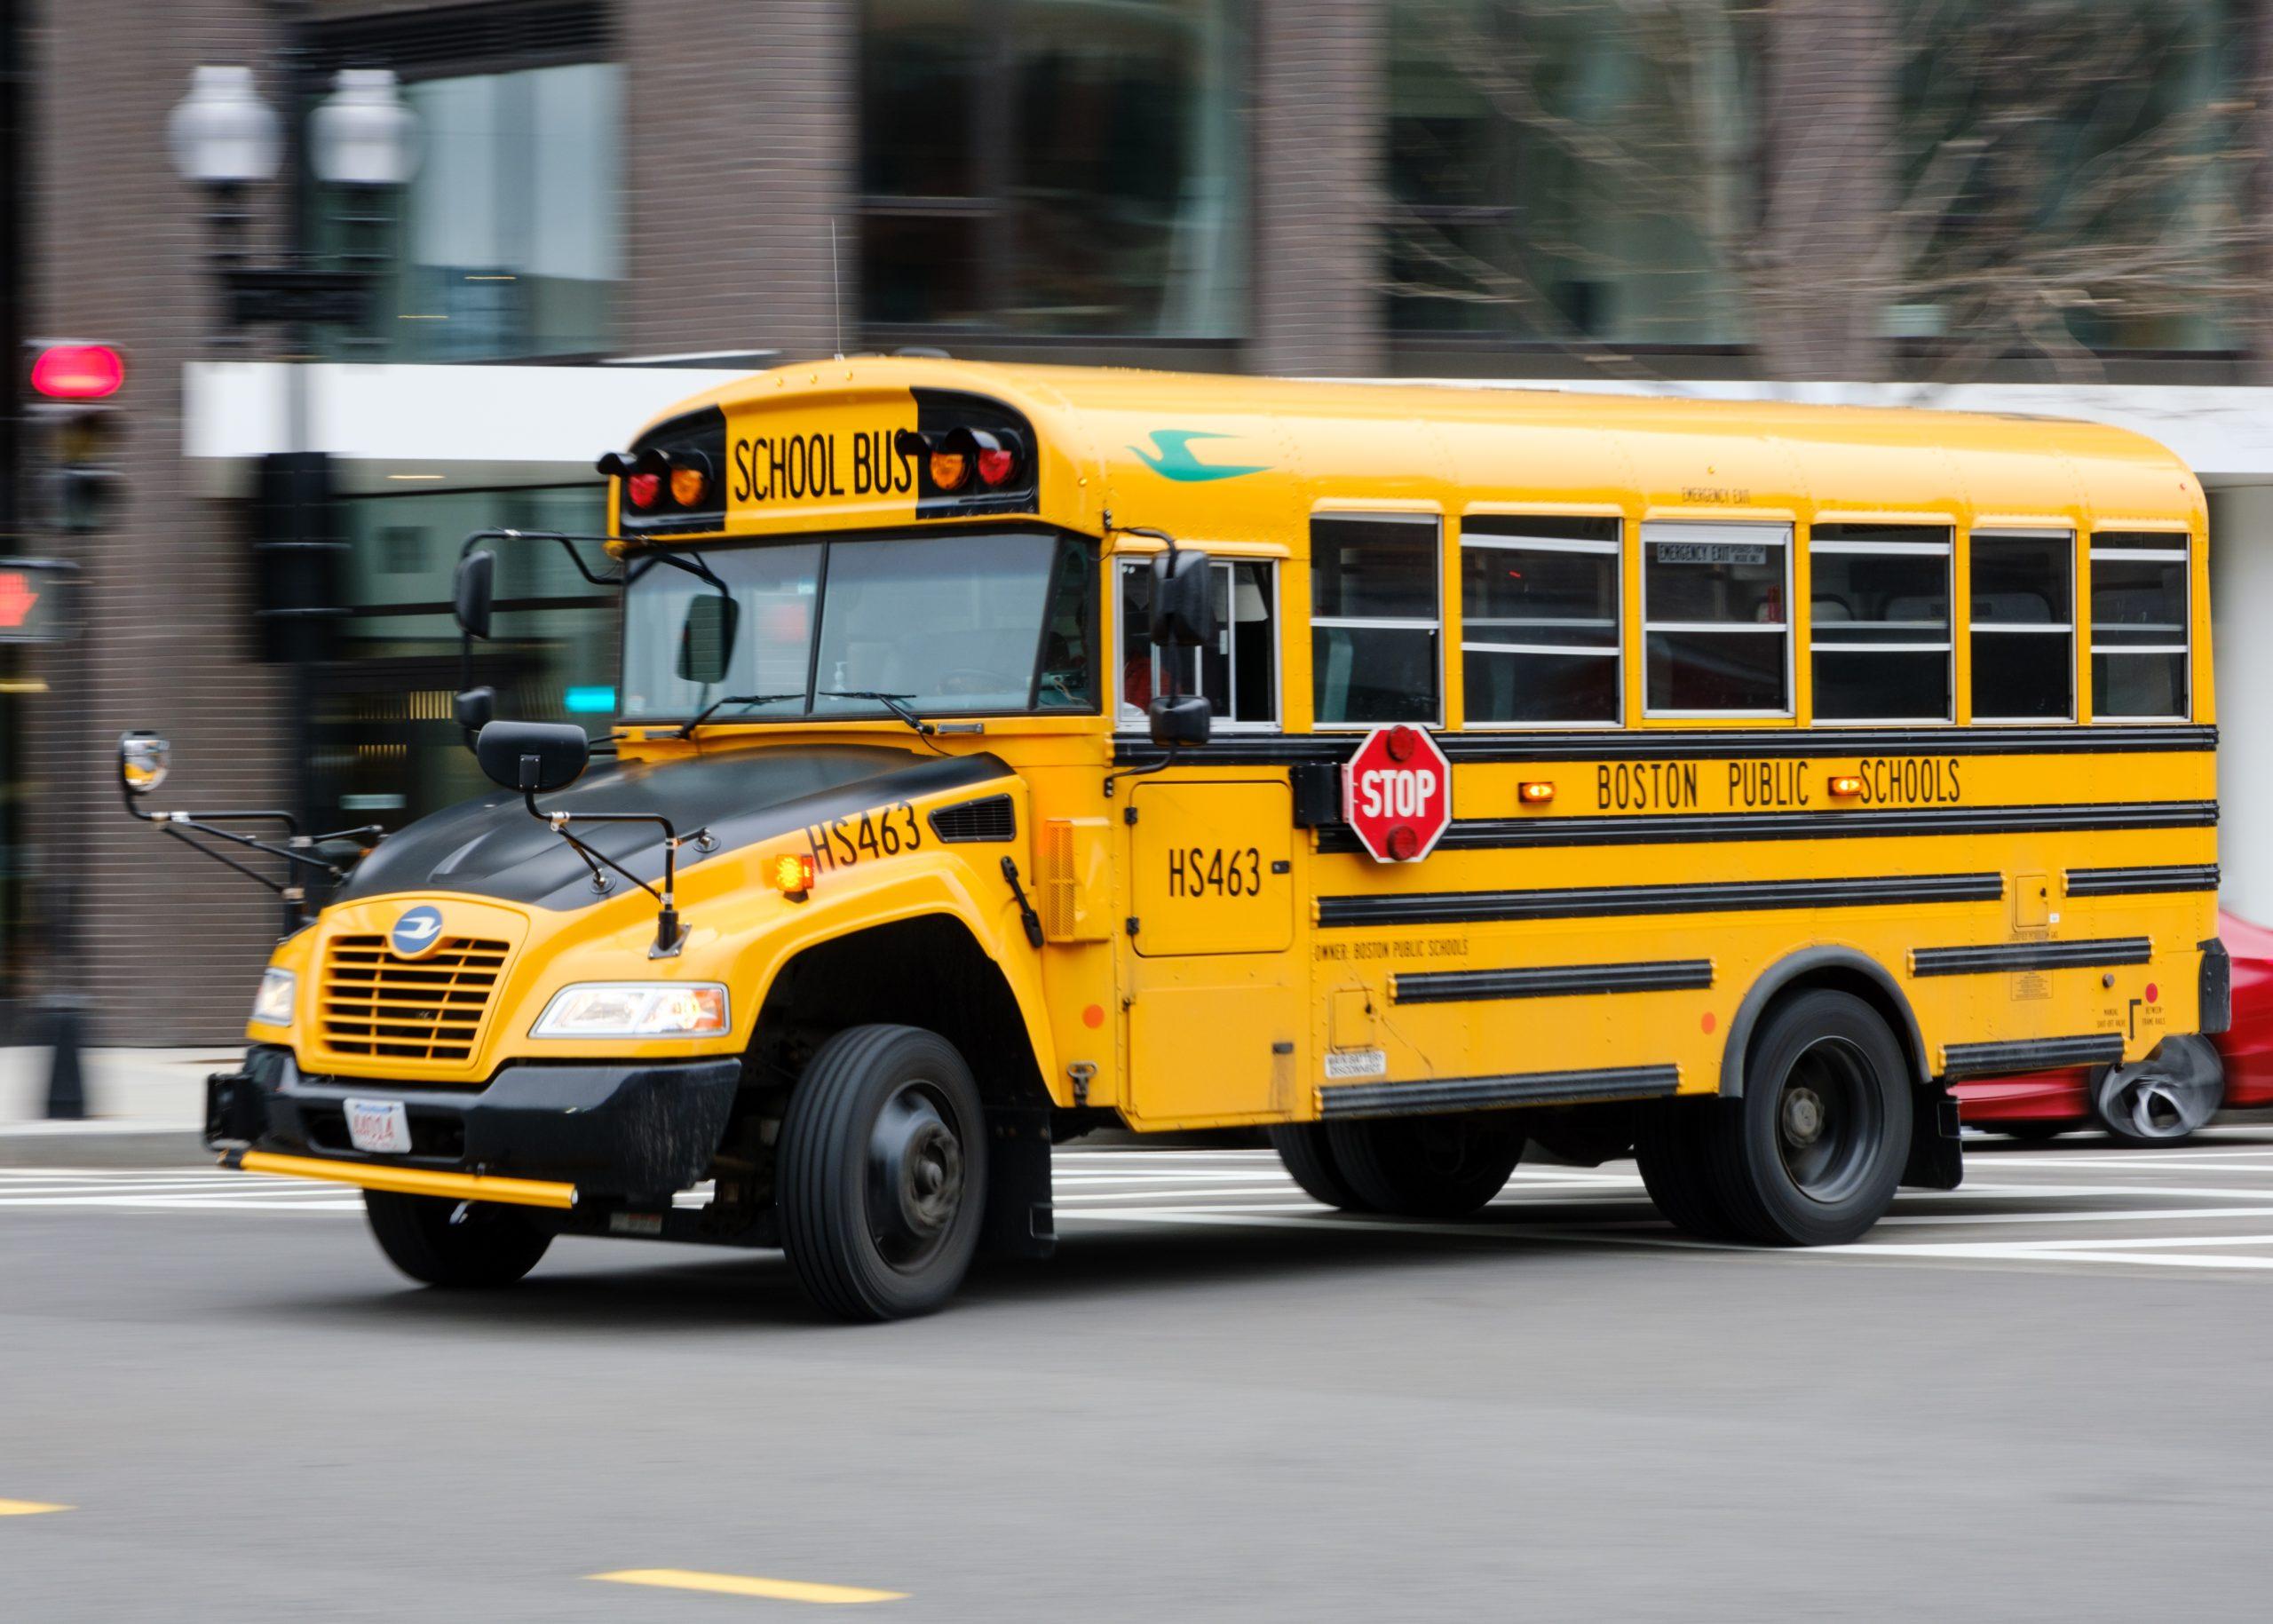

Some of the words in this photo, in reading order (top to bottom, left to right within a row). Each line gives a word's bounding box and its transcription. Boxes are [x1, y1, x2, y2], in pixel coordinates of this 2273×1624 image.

[734, 433, 845, 502] SCHOOL
[853, 428, 913, 495] BUS
[1681, 487, 1729, 503] EMERGENCY
[1732, 488, 1751, 504] EXIT
[1659, 544, 1707, 561] EMERGENCY
[1711, 545, 1730, 562] EXIT
[1361, 769, 1437, 818] STOP
[1598, 762, 1697, 810] BOSTON
[1729, 761, 1809, 807] PUBLIC
[1860, 758, 1960, 804] SCHOOLS
[806, 800, 921, 875] HS463
[1169, 848, 1260, 897] HS463
[1353, 941, 1389, 960] BOSTON
[1393, 940, 1424, 958] PUBLIC
[1429, 939, 1468, 957] SCHOOLS
